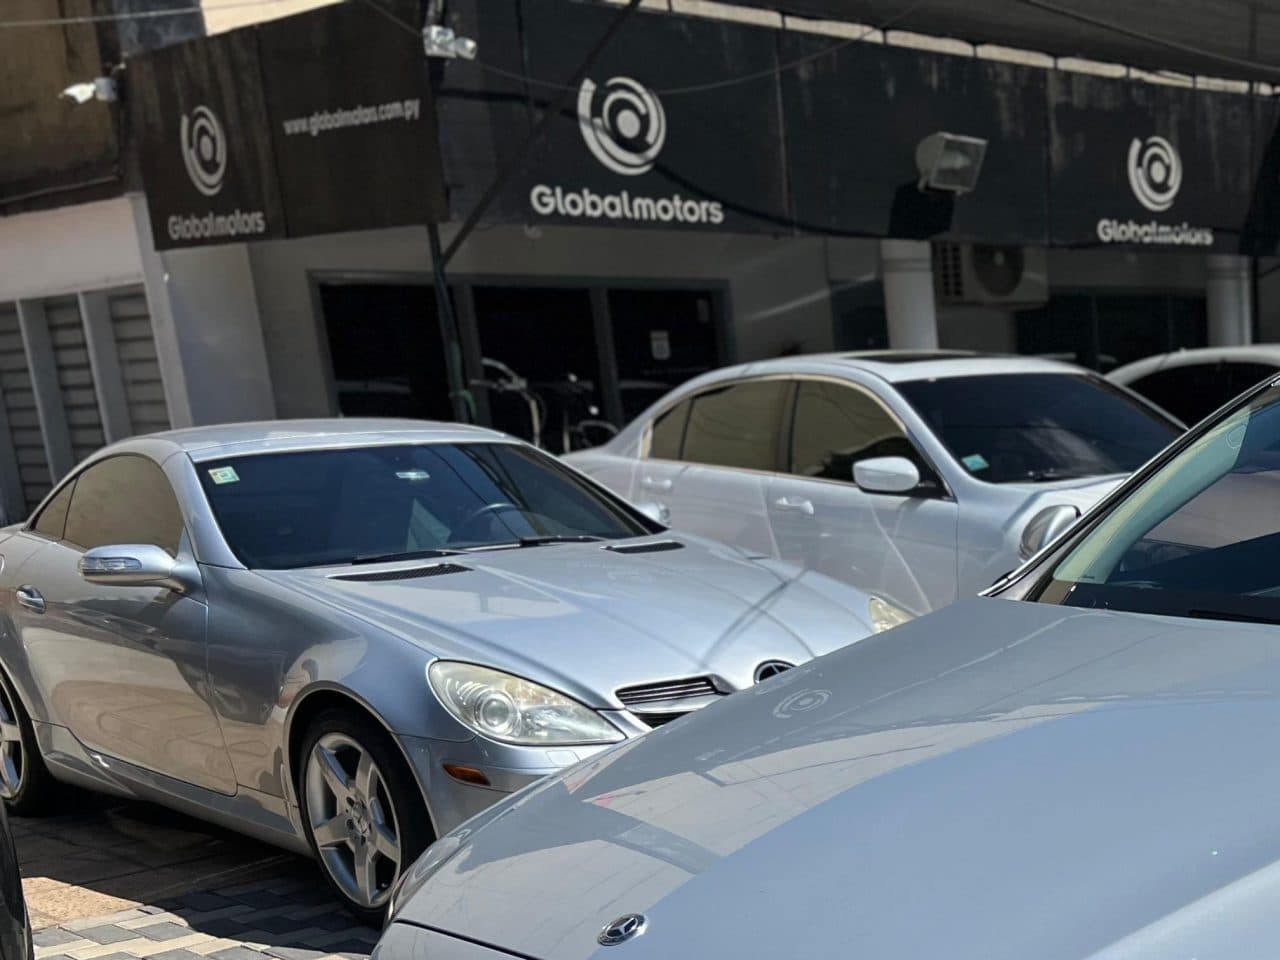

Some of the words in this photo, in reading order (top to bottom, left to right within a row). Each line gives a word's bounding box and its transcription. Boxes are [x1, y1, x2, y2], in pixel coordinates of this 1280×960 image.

[530, 184, 724, 224] Globalmotors
[168, 208, 265, 240] Globalmotors
[1097, 219, 1213, 245] Globalmotors
